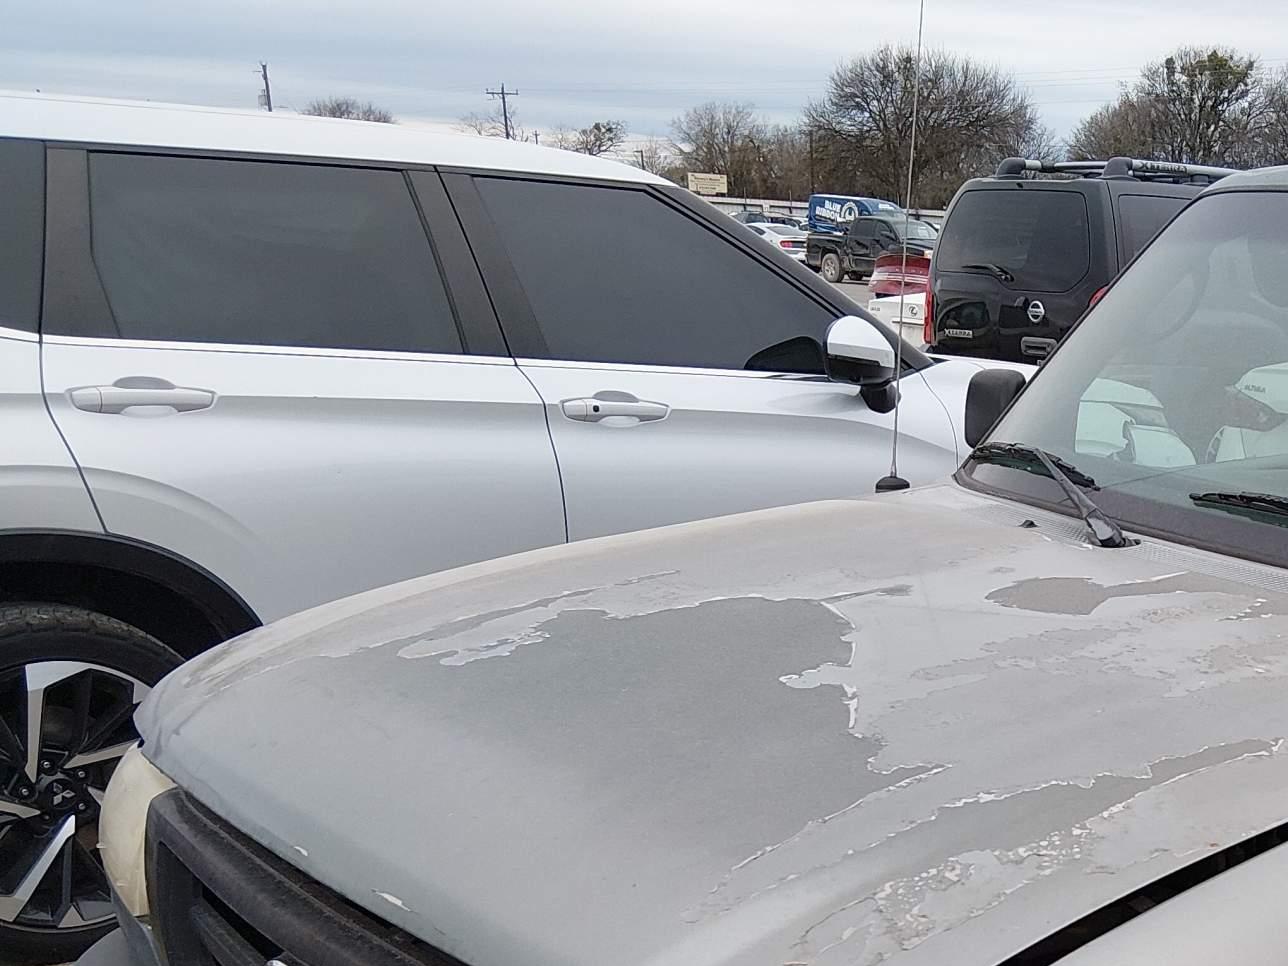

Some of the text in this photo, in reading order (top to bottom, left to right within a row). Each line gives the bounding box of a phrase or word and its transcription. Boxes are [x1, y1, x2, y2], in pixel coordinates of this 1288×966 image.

[824, 200, 842, 213] BLUE
[815, 205, 841, 222] RIBBON
[943, 328, 973, 339] XTERRA
